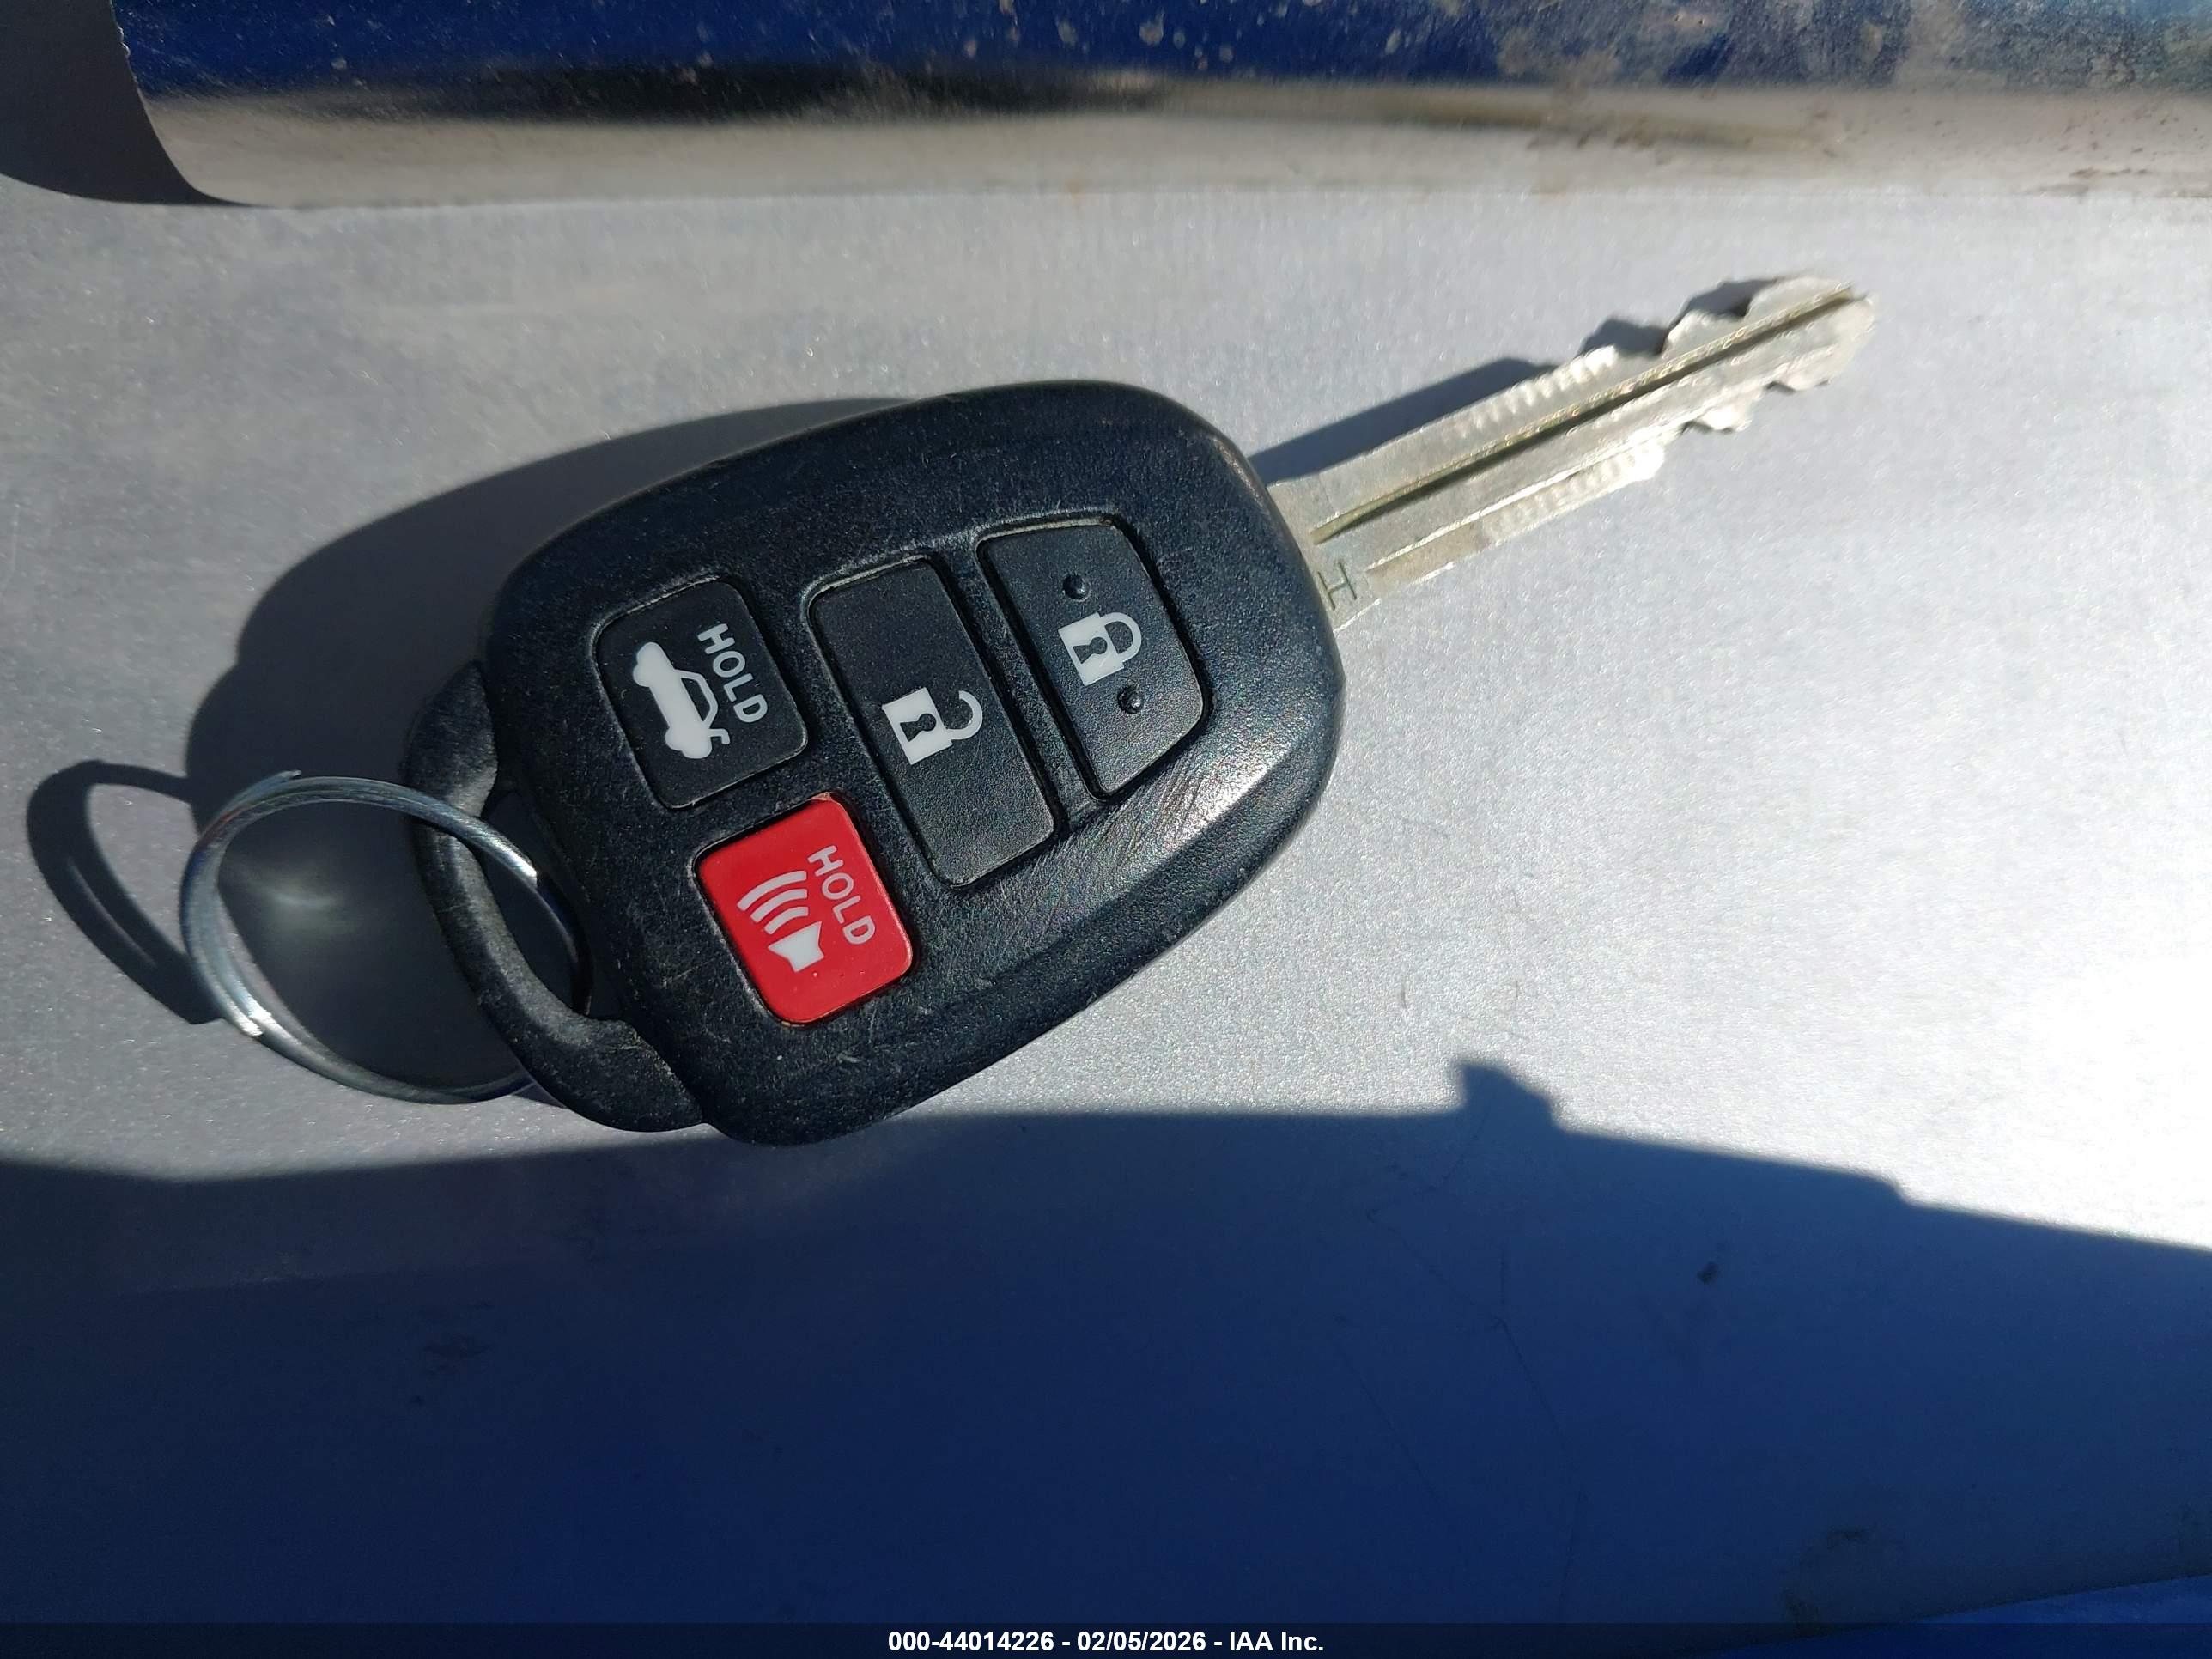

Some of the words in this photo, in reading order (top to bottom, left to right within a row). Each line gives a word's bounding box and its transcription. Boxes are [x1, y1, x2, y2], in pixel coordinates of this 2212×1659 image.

[1317, 562, 1358, 610] H
[697, 623, 769, 722] HOLD
[807, 845, 876, 945] HOLD
